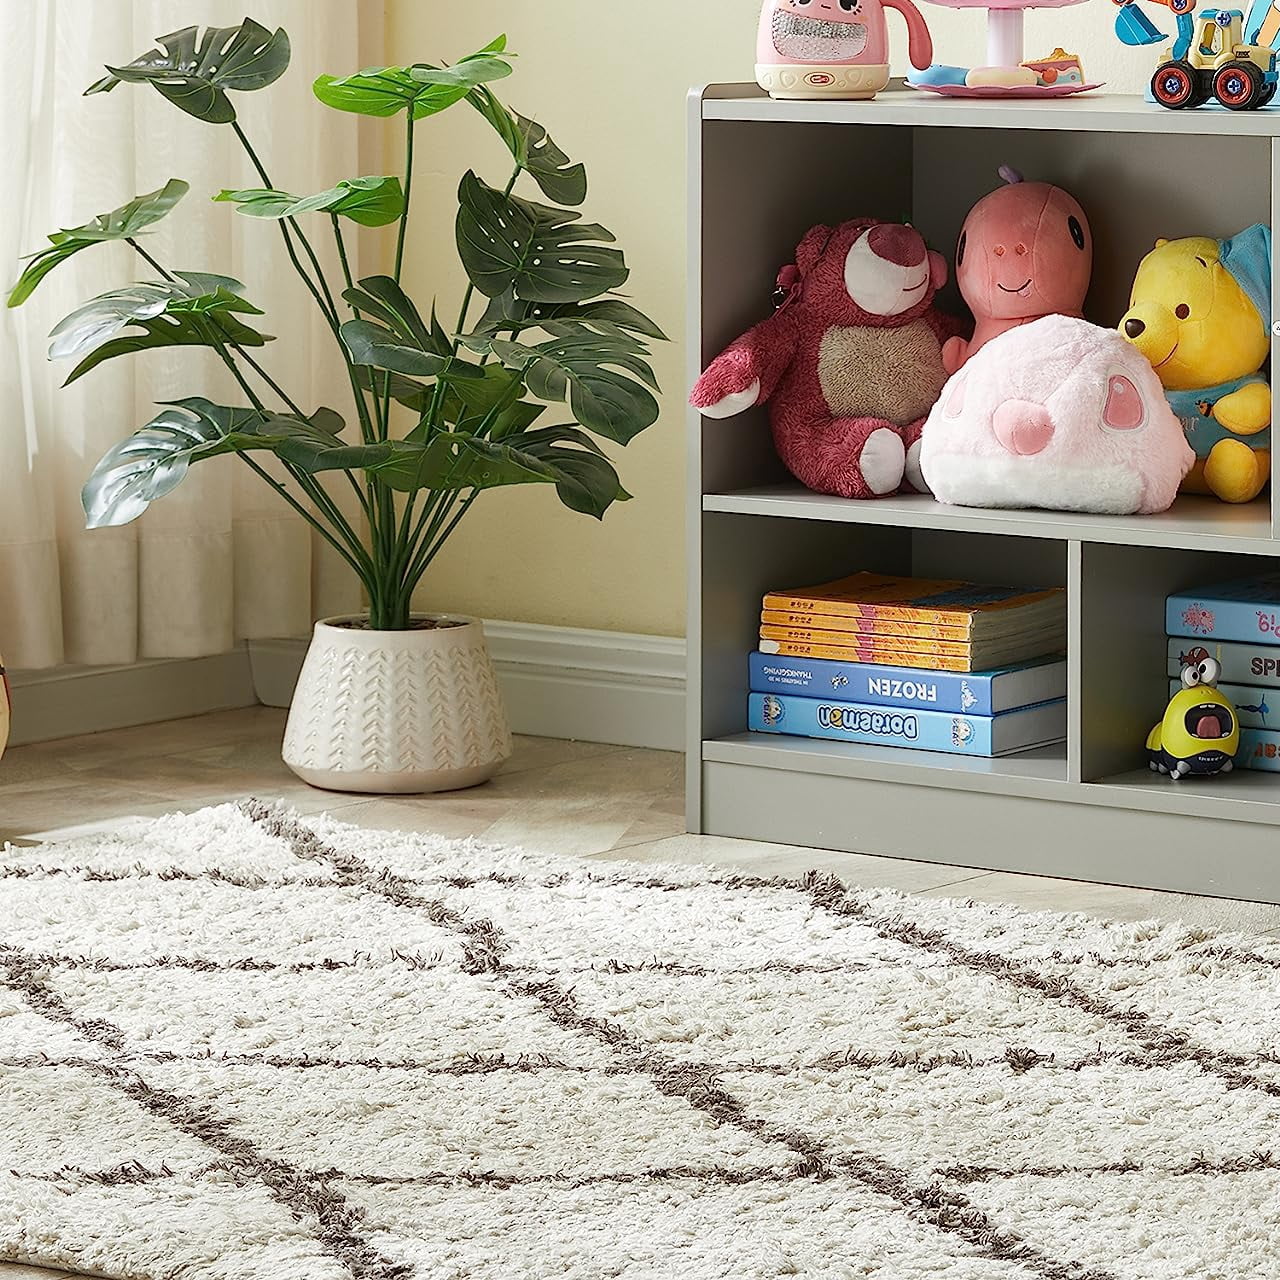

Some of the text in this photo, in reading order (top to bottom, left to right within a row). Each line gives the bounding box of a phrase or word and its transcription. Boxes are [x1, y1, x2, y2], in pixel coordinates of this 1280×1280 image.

[763, 666, 812, 679] THANKSGIVING
[867, 677, 938, 702] FROZEN
[818, 705, 918, 739] Doraemon
